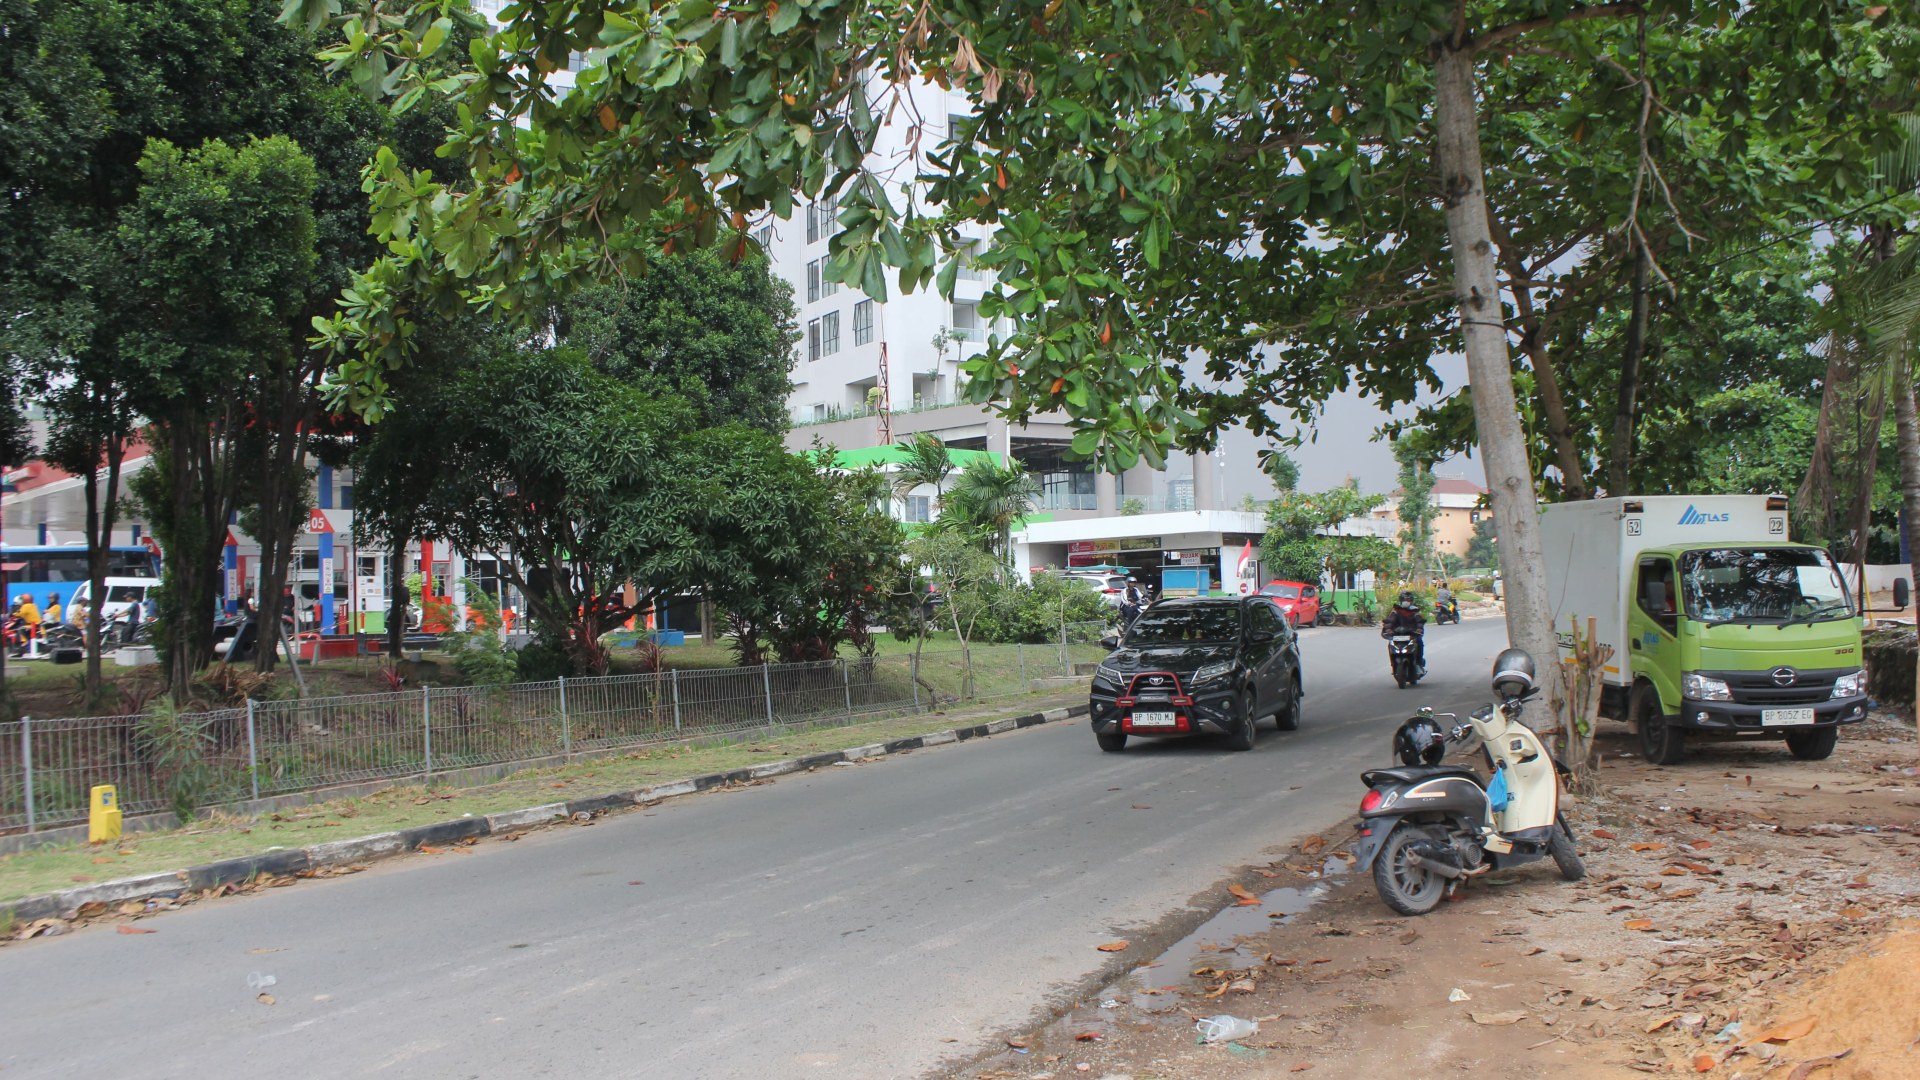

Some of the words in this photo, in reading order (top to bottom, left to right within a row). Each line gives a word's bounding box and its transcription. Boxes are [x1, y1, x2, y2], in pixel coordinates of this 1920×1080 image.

[311, 517, 325, 530] 05
[1628, 521, 1640, 534] 52
[1770, 520, 1783, 532] 22
[1134, 713, 1143, 721] BP
[1146, 713, 1162, 721] 1670
[1164, 713, 1173, 721] MJ
[1765, 711, 1775, 721] BP
